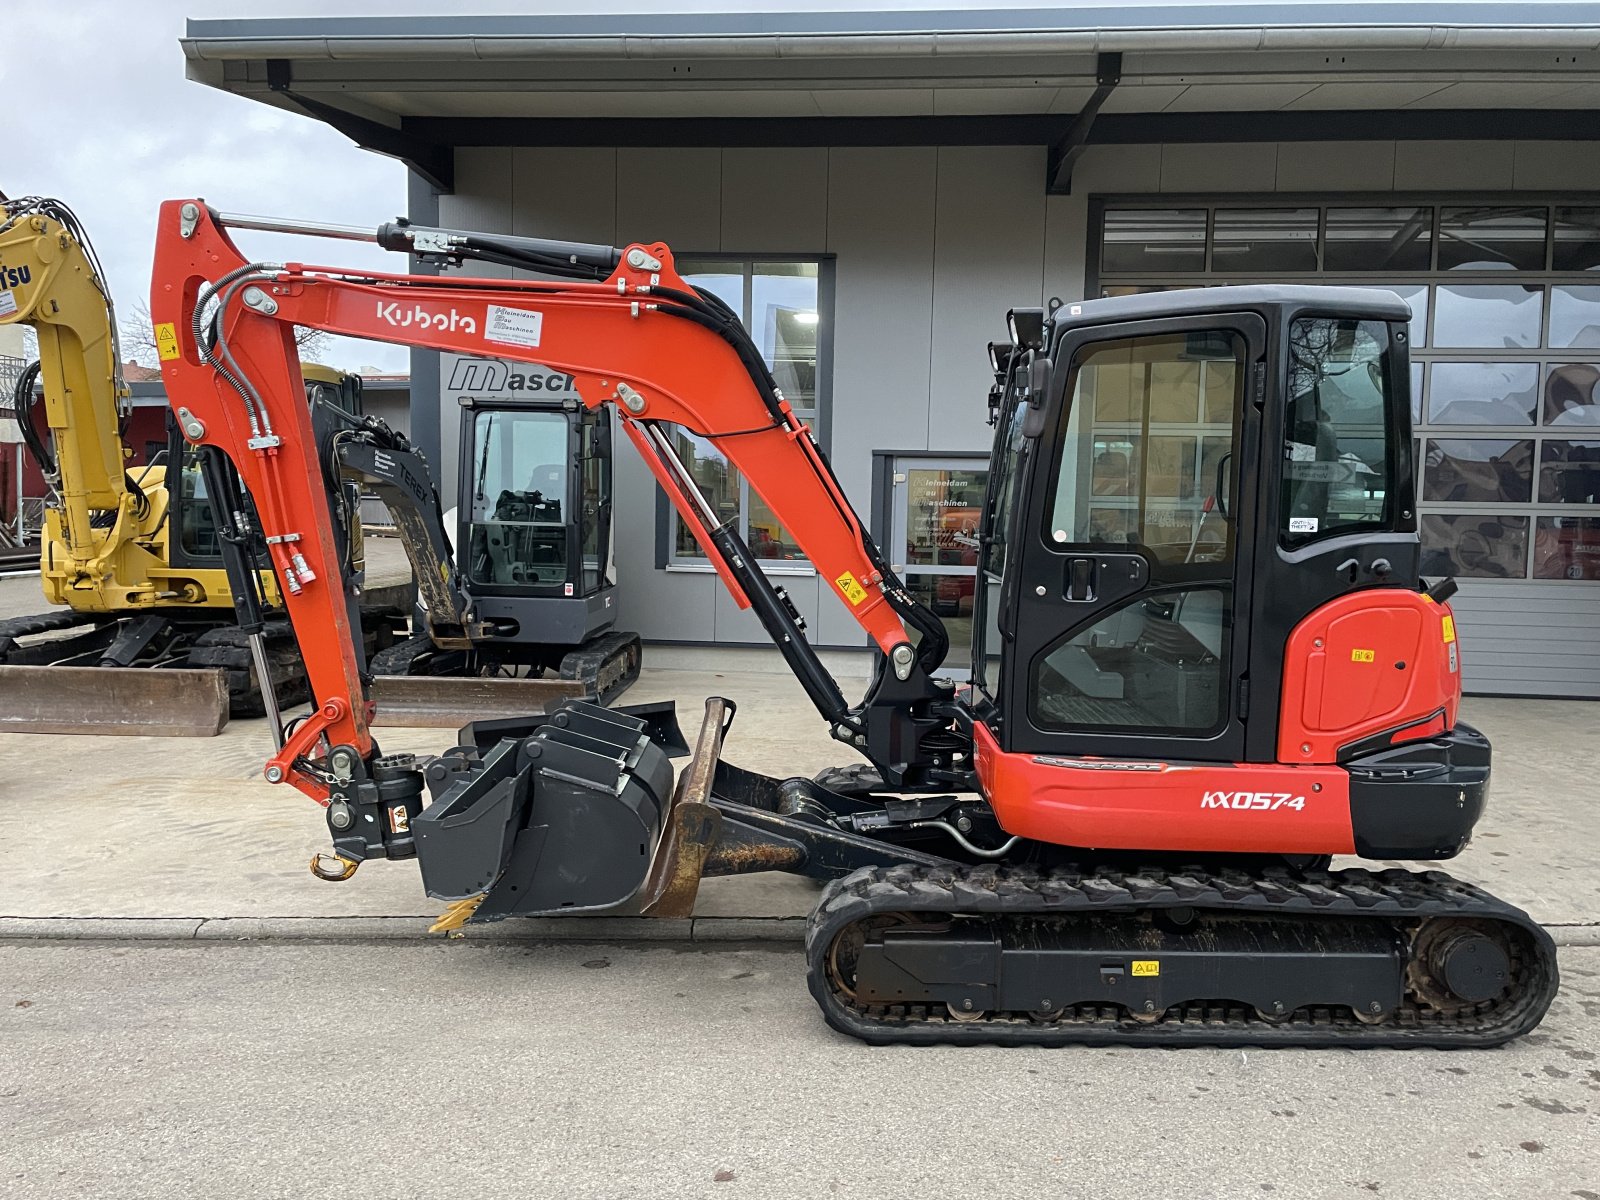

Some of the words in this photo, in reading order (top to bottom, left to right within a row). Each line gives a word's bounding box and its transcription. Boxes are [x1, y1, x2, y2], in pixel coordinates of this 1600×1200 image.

[376, 301, 476, 334] Kubota
[494, 322, 534, 333] Maschinen
[400, 462, 428, 506] TEREX
[1569, 567, 1580, 577] 20
